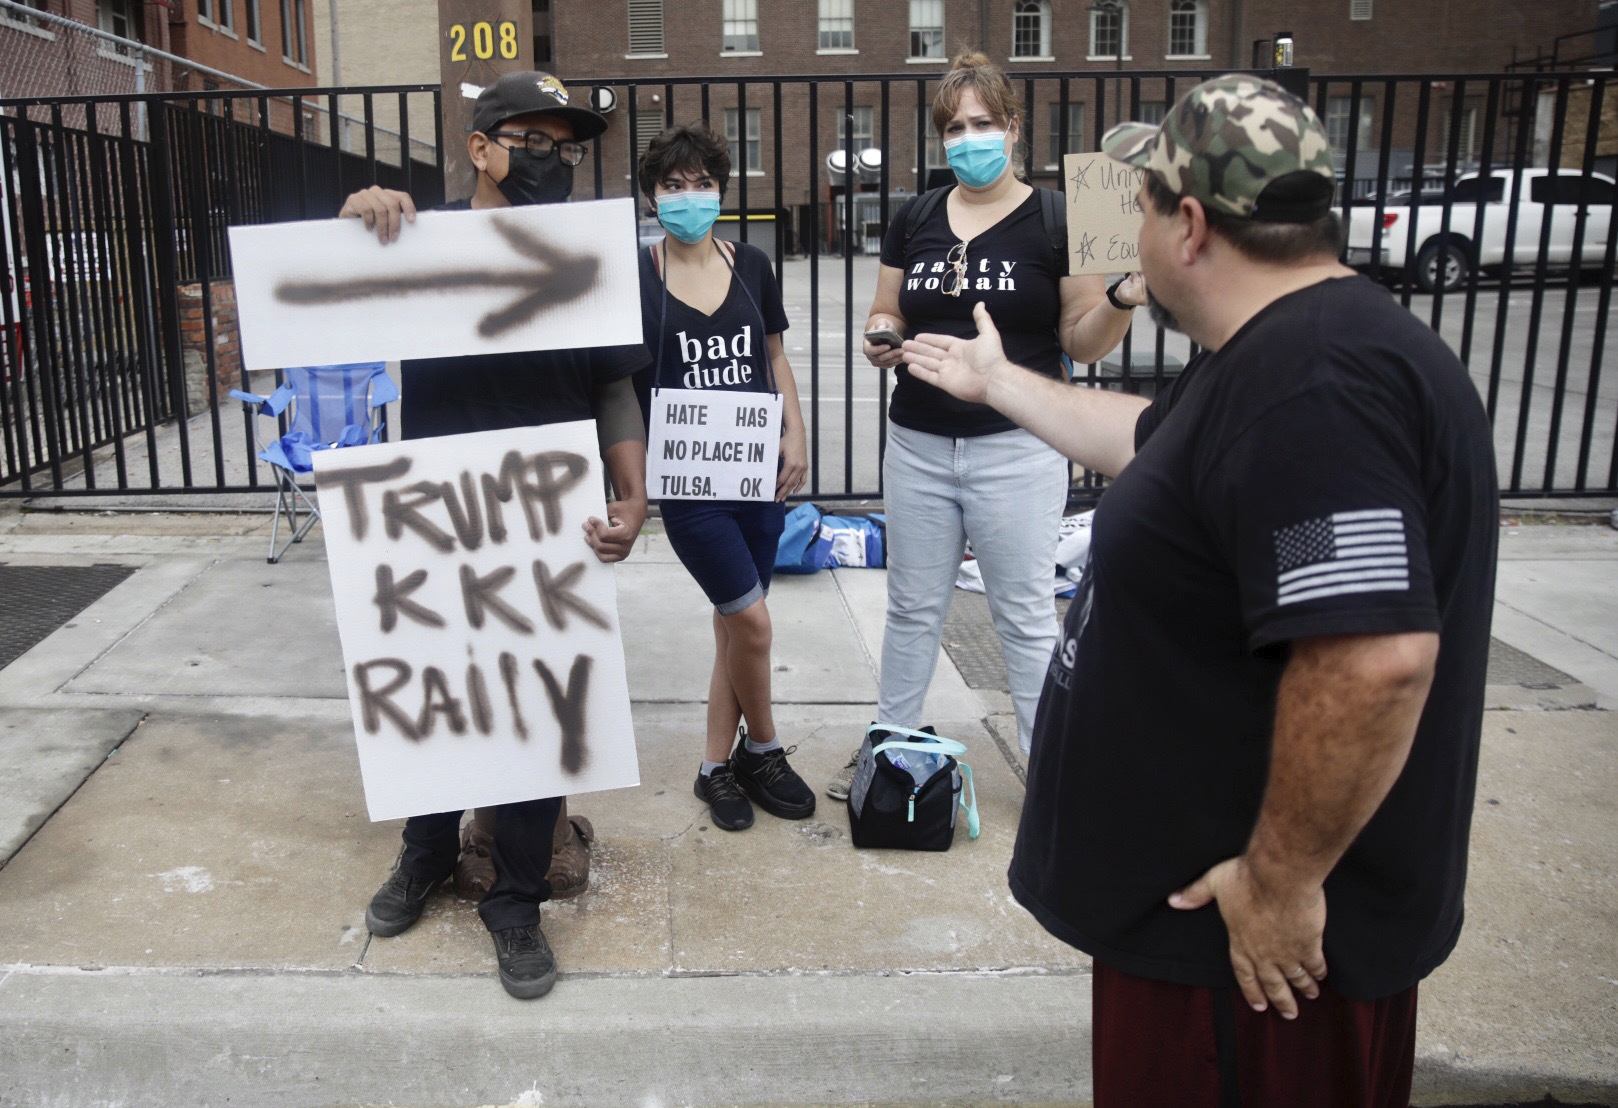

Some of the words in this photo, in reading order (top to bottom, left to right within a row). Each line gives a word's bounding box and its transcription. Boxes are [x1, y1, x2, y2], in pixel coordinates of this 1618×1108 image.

[450, 21, 518, 62] 208
[911, 258, 1017, 277] naty
[676, 325, 753, 364] bad
[683, 359, 752, 389] dude
[665, 403, 708, 426] HATE
[735, 406, 768, 428] HAS
[663, 439, 687, 461] NO
[691, 441, 744, 463] PLACE
[747, 442, 765, 463] IN
[661, 475, 717, 499] TULSA,
[740, 477, 763, 498] OK
[315, 450, 589, 553] TRUMP
